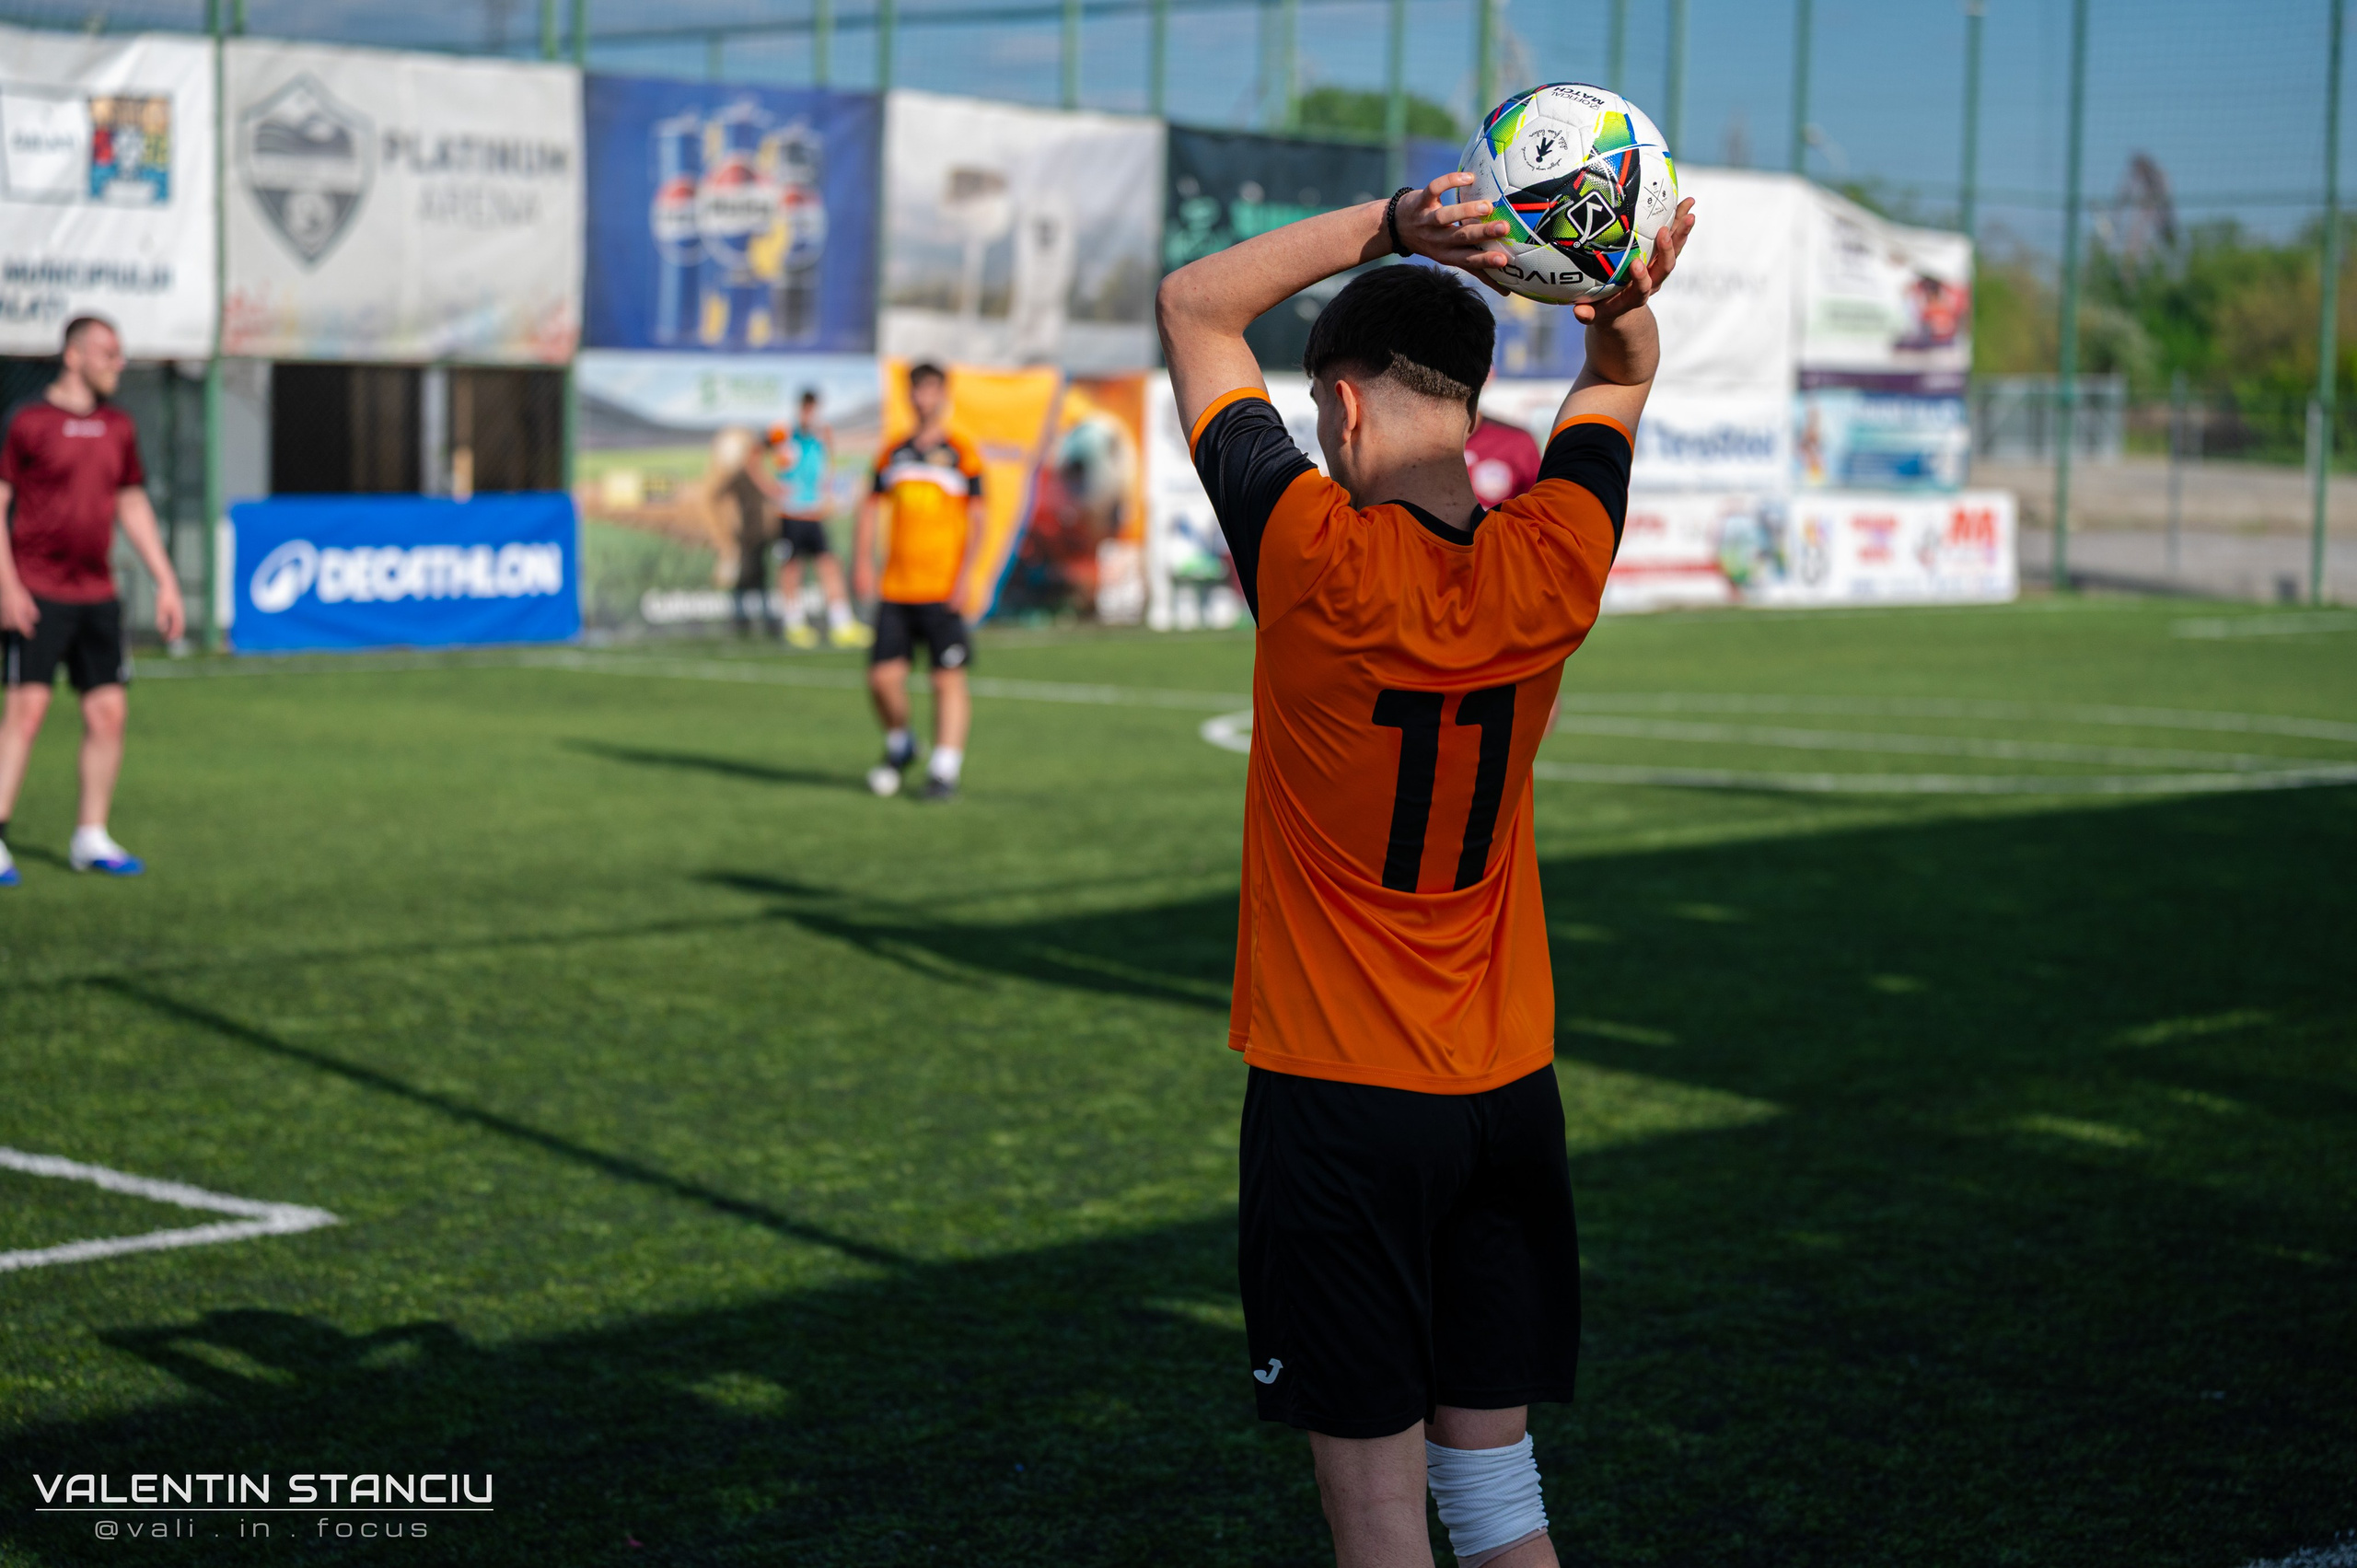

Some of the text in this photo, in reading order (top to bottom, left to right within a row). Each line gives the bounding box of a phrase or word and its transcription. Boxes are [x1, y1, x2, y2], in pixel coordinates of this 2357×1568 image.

[1551, 92, 1591, 106] OFFICIAL
[1554, 87, 1605, 105] MATCH
[380, 134, 569, 178] PLATINUM
[1499, 263, 1584, 285] GIVO
[318, 541, 563, 604] DECATHLON
[1372, 683, 1516, 894] 11
